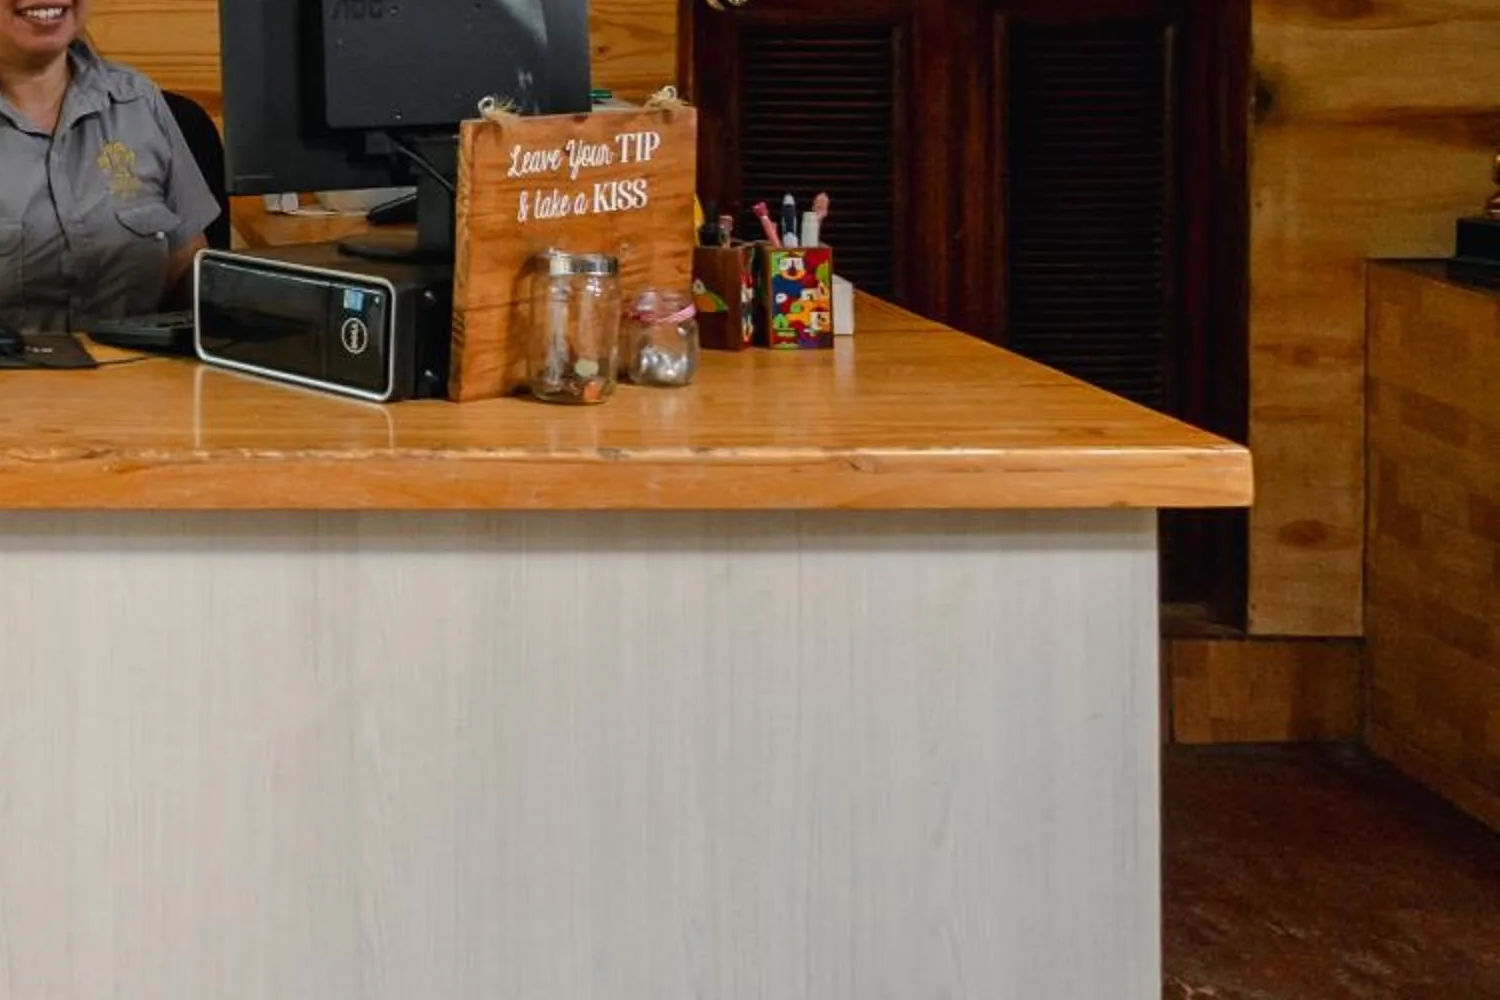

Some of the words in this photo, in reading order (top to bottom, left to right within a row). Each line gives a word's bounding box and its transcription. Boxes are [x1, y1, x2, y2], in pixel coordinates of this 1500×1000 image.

[507, 145, 562, 178] Leave
[565, 139, 614, 181] Your
[615, 131, 660, 164] TIP
[534, 188, 571, 220] take
[573, 193, 587, 215] a
[592, 178, 648, 214] KISS
